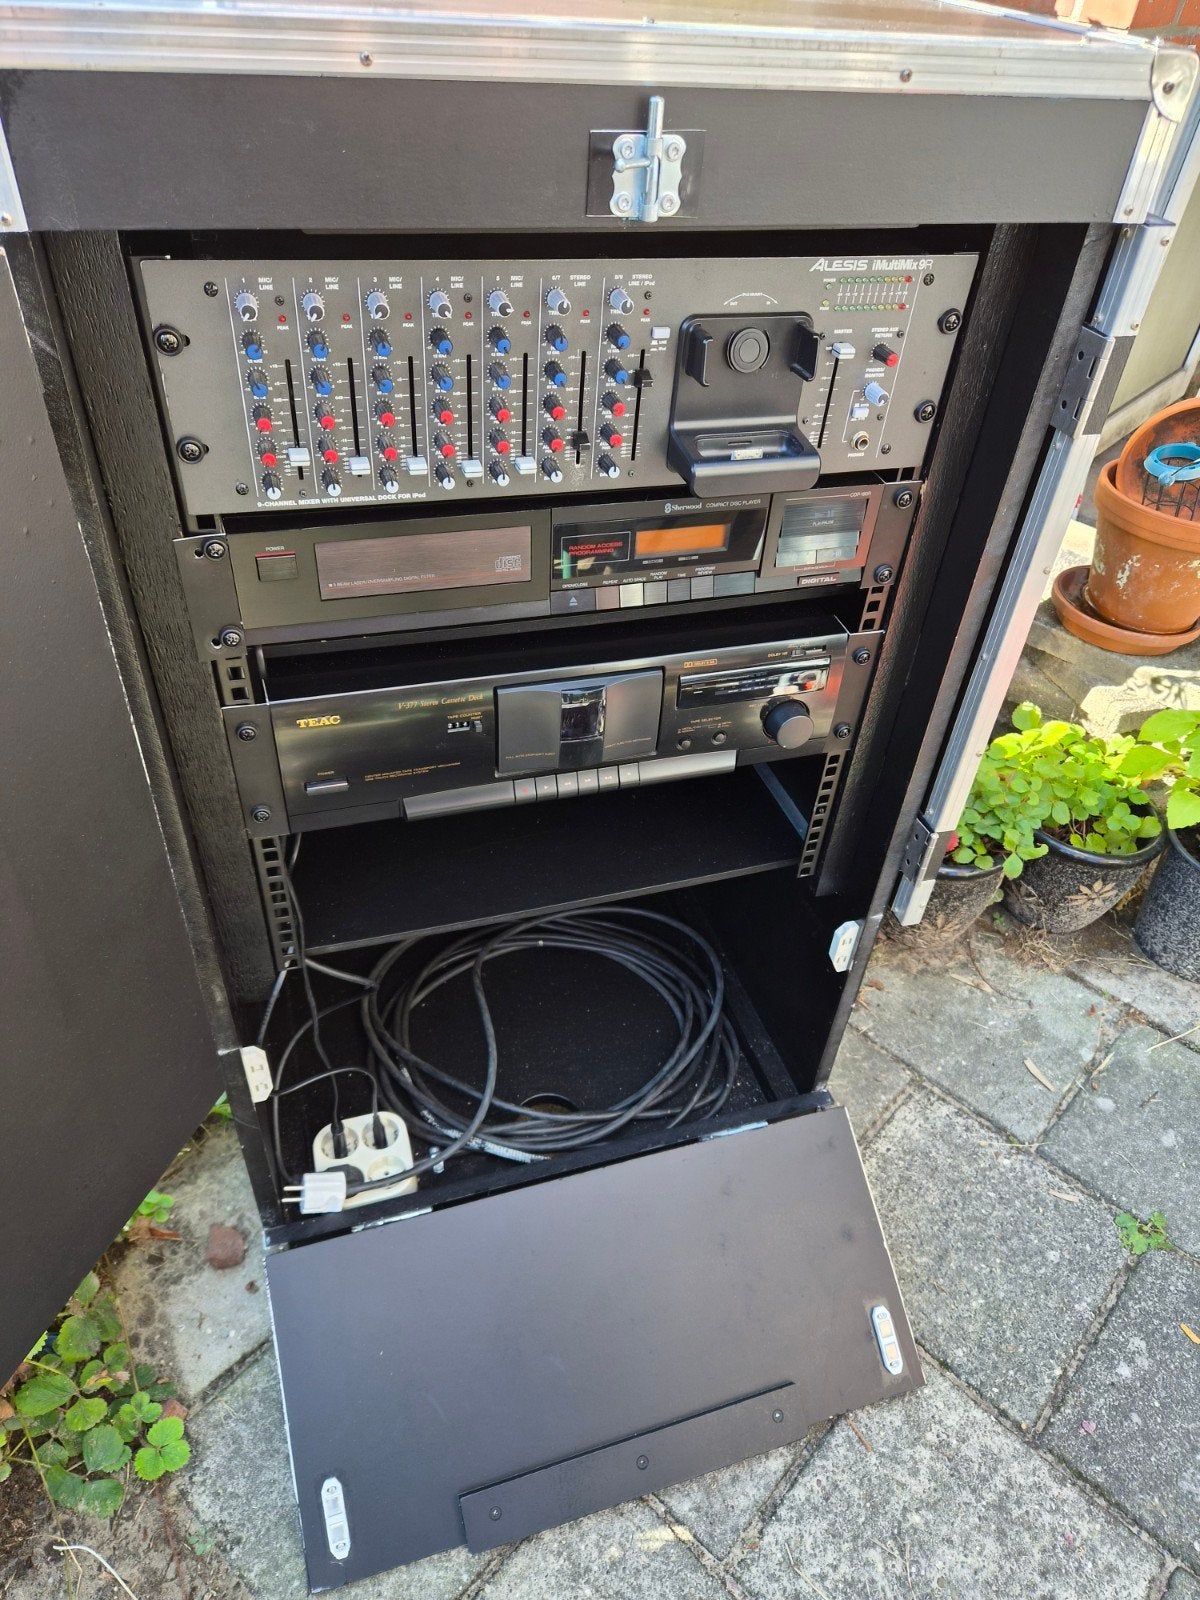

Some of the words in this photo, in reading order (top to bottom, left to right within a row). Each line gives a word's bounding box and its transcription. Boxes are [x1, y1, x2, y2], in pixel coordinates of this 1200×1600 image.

[809, 258, 868, 272] ALESIS
[257, 499, 297, 508] 9-CHANNEL
[298, 498, 321, 506] MIXER
[339, 494, 377, 503] UNIVERSAL
[671, 502, 702, 511] Sherwood
[801, 576, 837, 585] DIGITAL
[468, 692, 484, 702] Deck
[296, 715, 341, 728] TEAC
